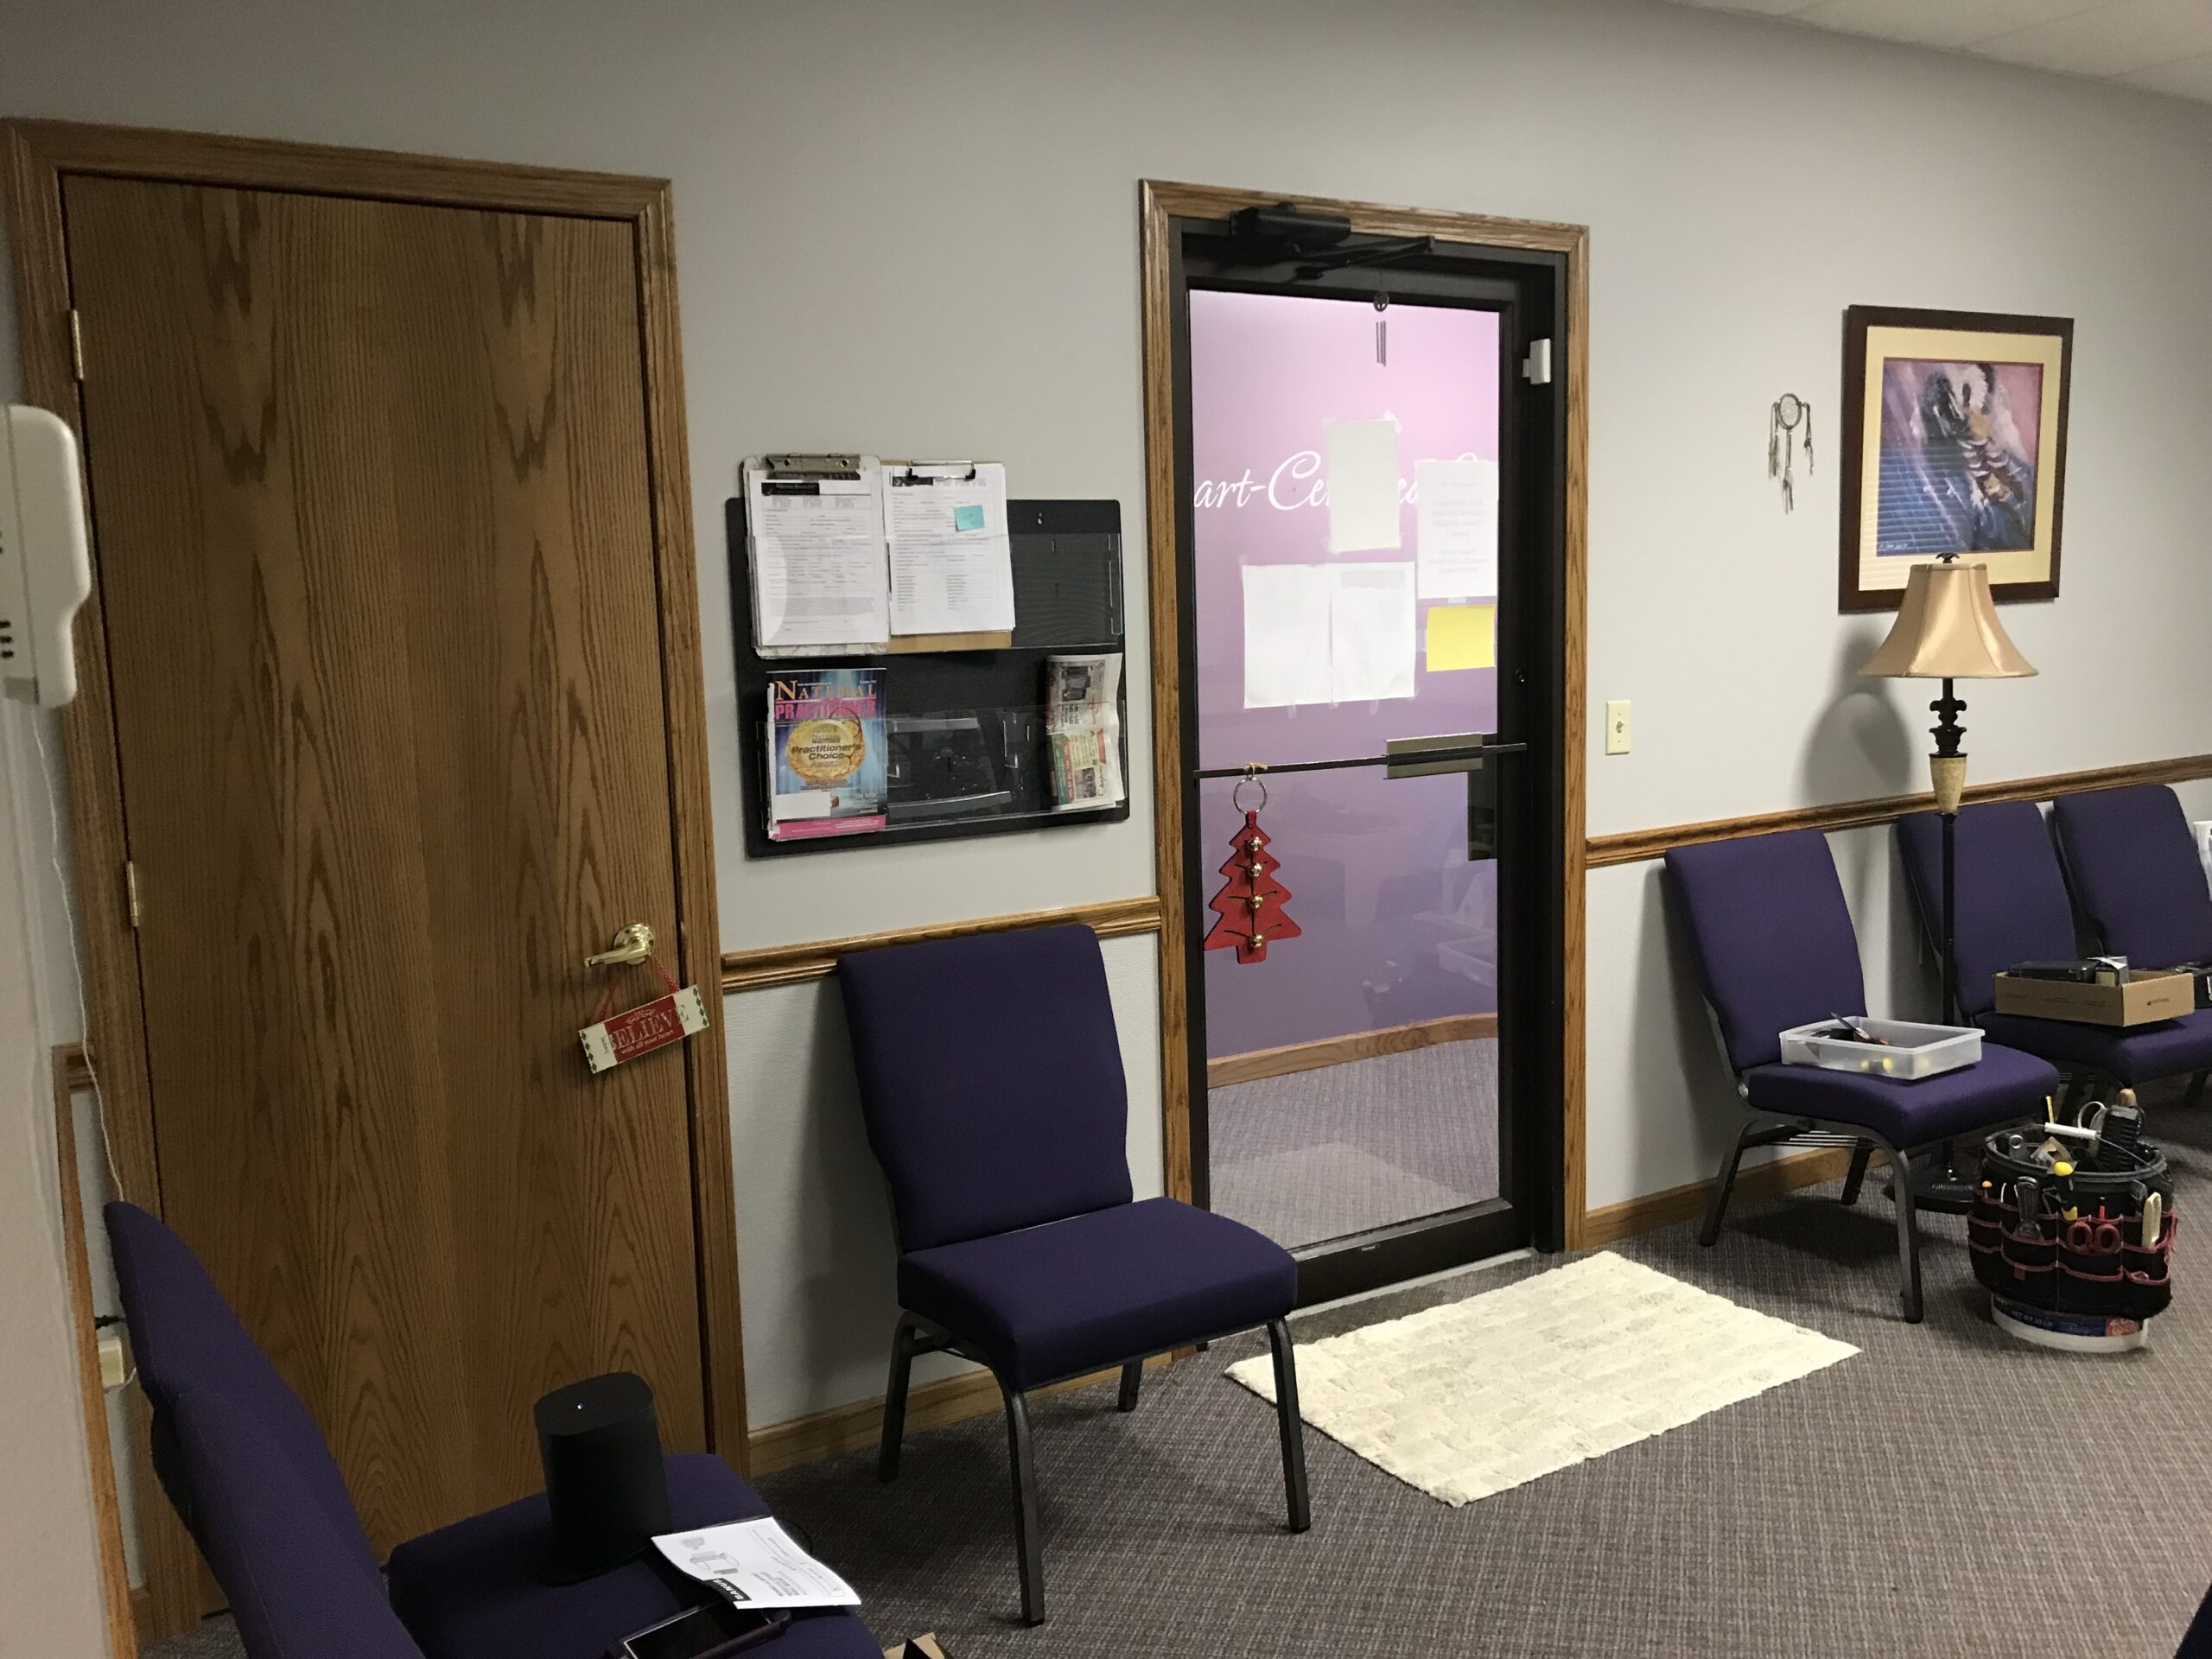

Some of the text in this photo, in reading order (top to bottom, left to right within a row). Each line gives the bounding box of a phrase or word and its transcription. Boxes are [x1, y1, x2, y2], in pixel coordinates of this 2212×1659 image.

[808, 752, 846, 761] Choice
[601, 1005, 690, 1054] BELIEVE
[621, 1045, 635, 1055] with
[644, 1036, 658, 1047] your
[658, 1029, 674, 1040] heart
